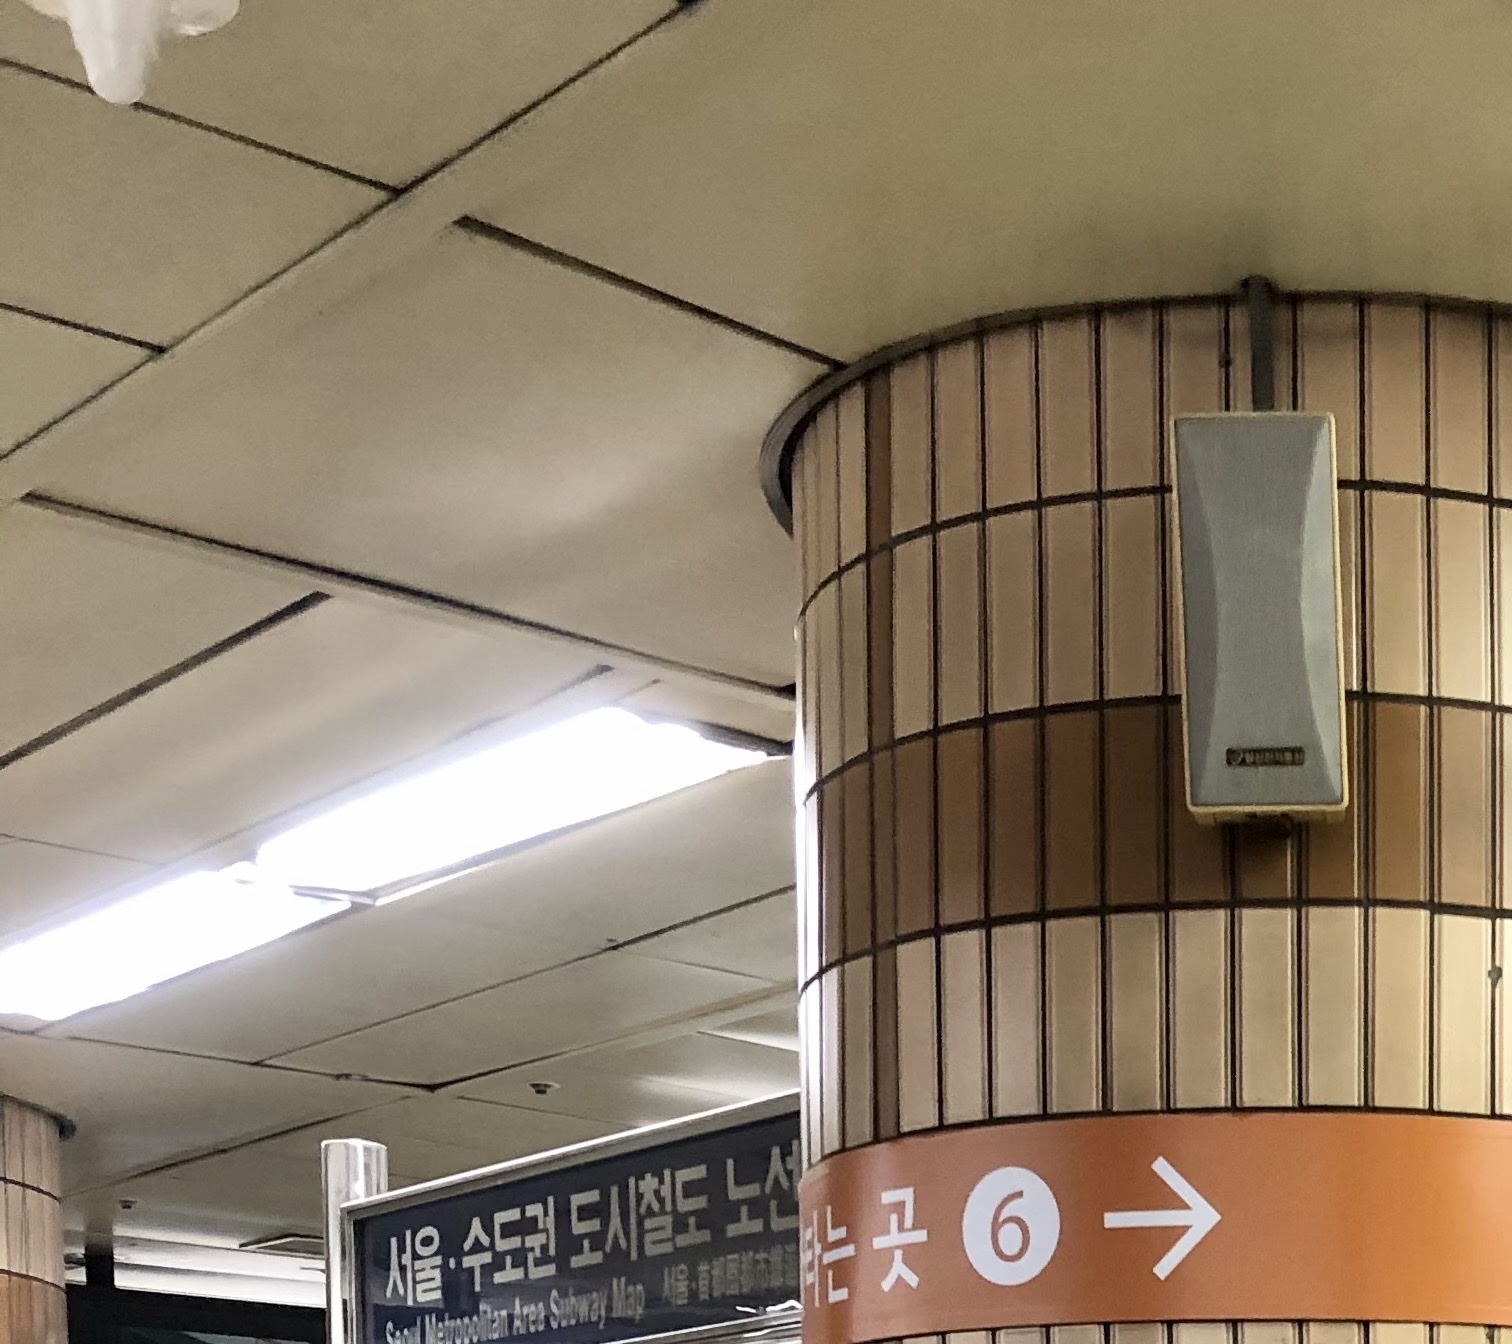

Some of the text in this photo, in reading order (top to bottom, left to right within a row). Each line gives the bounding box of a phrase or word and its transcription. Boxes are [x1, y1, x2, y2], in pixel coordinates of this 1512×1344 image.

[569, 1164, 711, 1269] 도시철도
[872, 1186, 928, 1293] 곳
[513, 1296, 546, 1336] Area
[550, 1286, 608, 1330] Subway
[612, 1275, 646, 1324] Map
